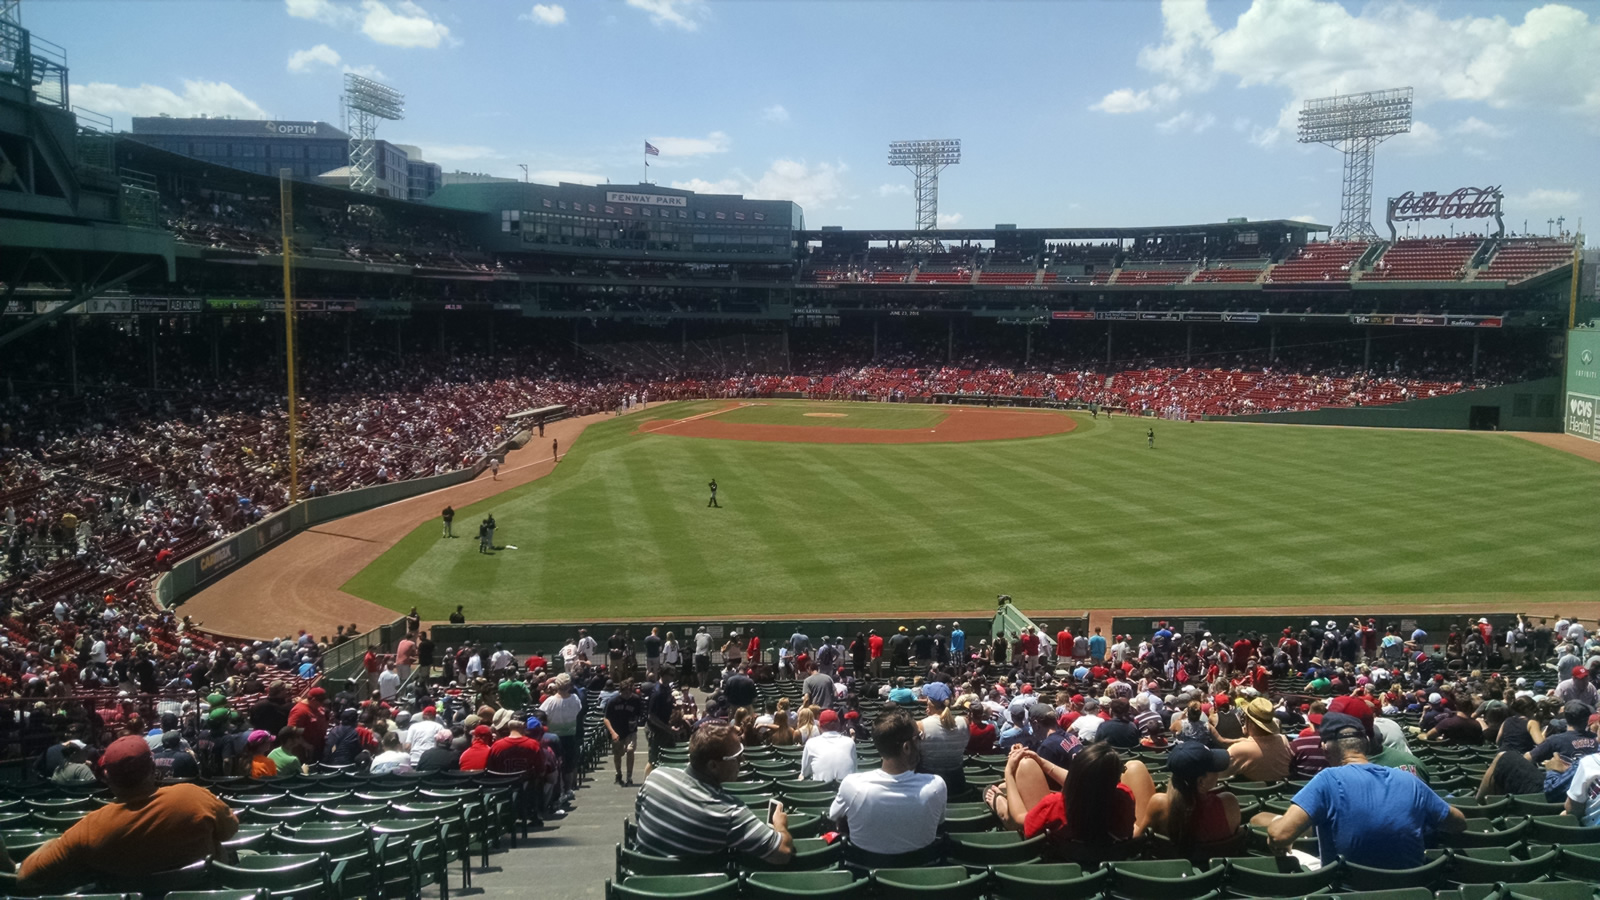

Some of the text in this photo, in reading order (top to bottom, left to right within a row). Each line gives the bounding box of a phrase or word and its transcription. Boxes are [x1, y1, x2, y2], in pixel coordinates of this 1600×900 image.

[279, 125, 316, 134] OPTUM
[611, 193, 682, 205] FENWAY PARK
[1391, 185, 1501, 221] Coca-Cola
[1577, 400, 1592, 418] CVS
[1569, 415, 1590, 435] Health
